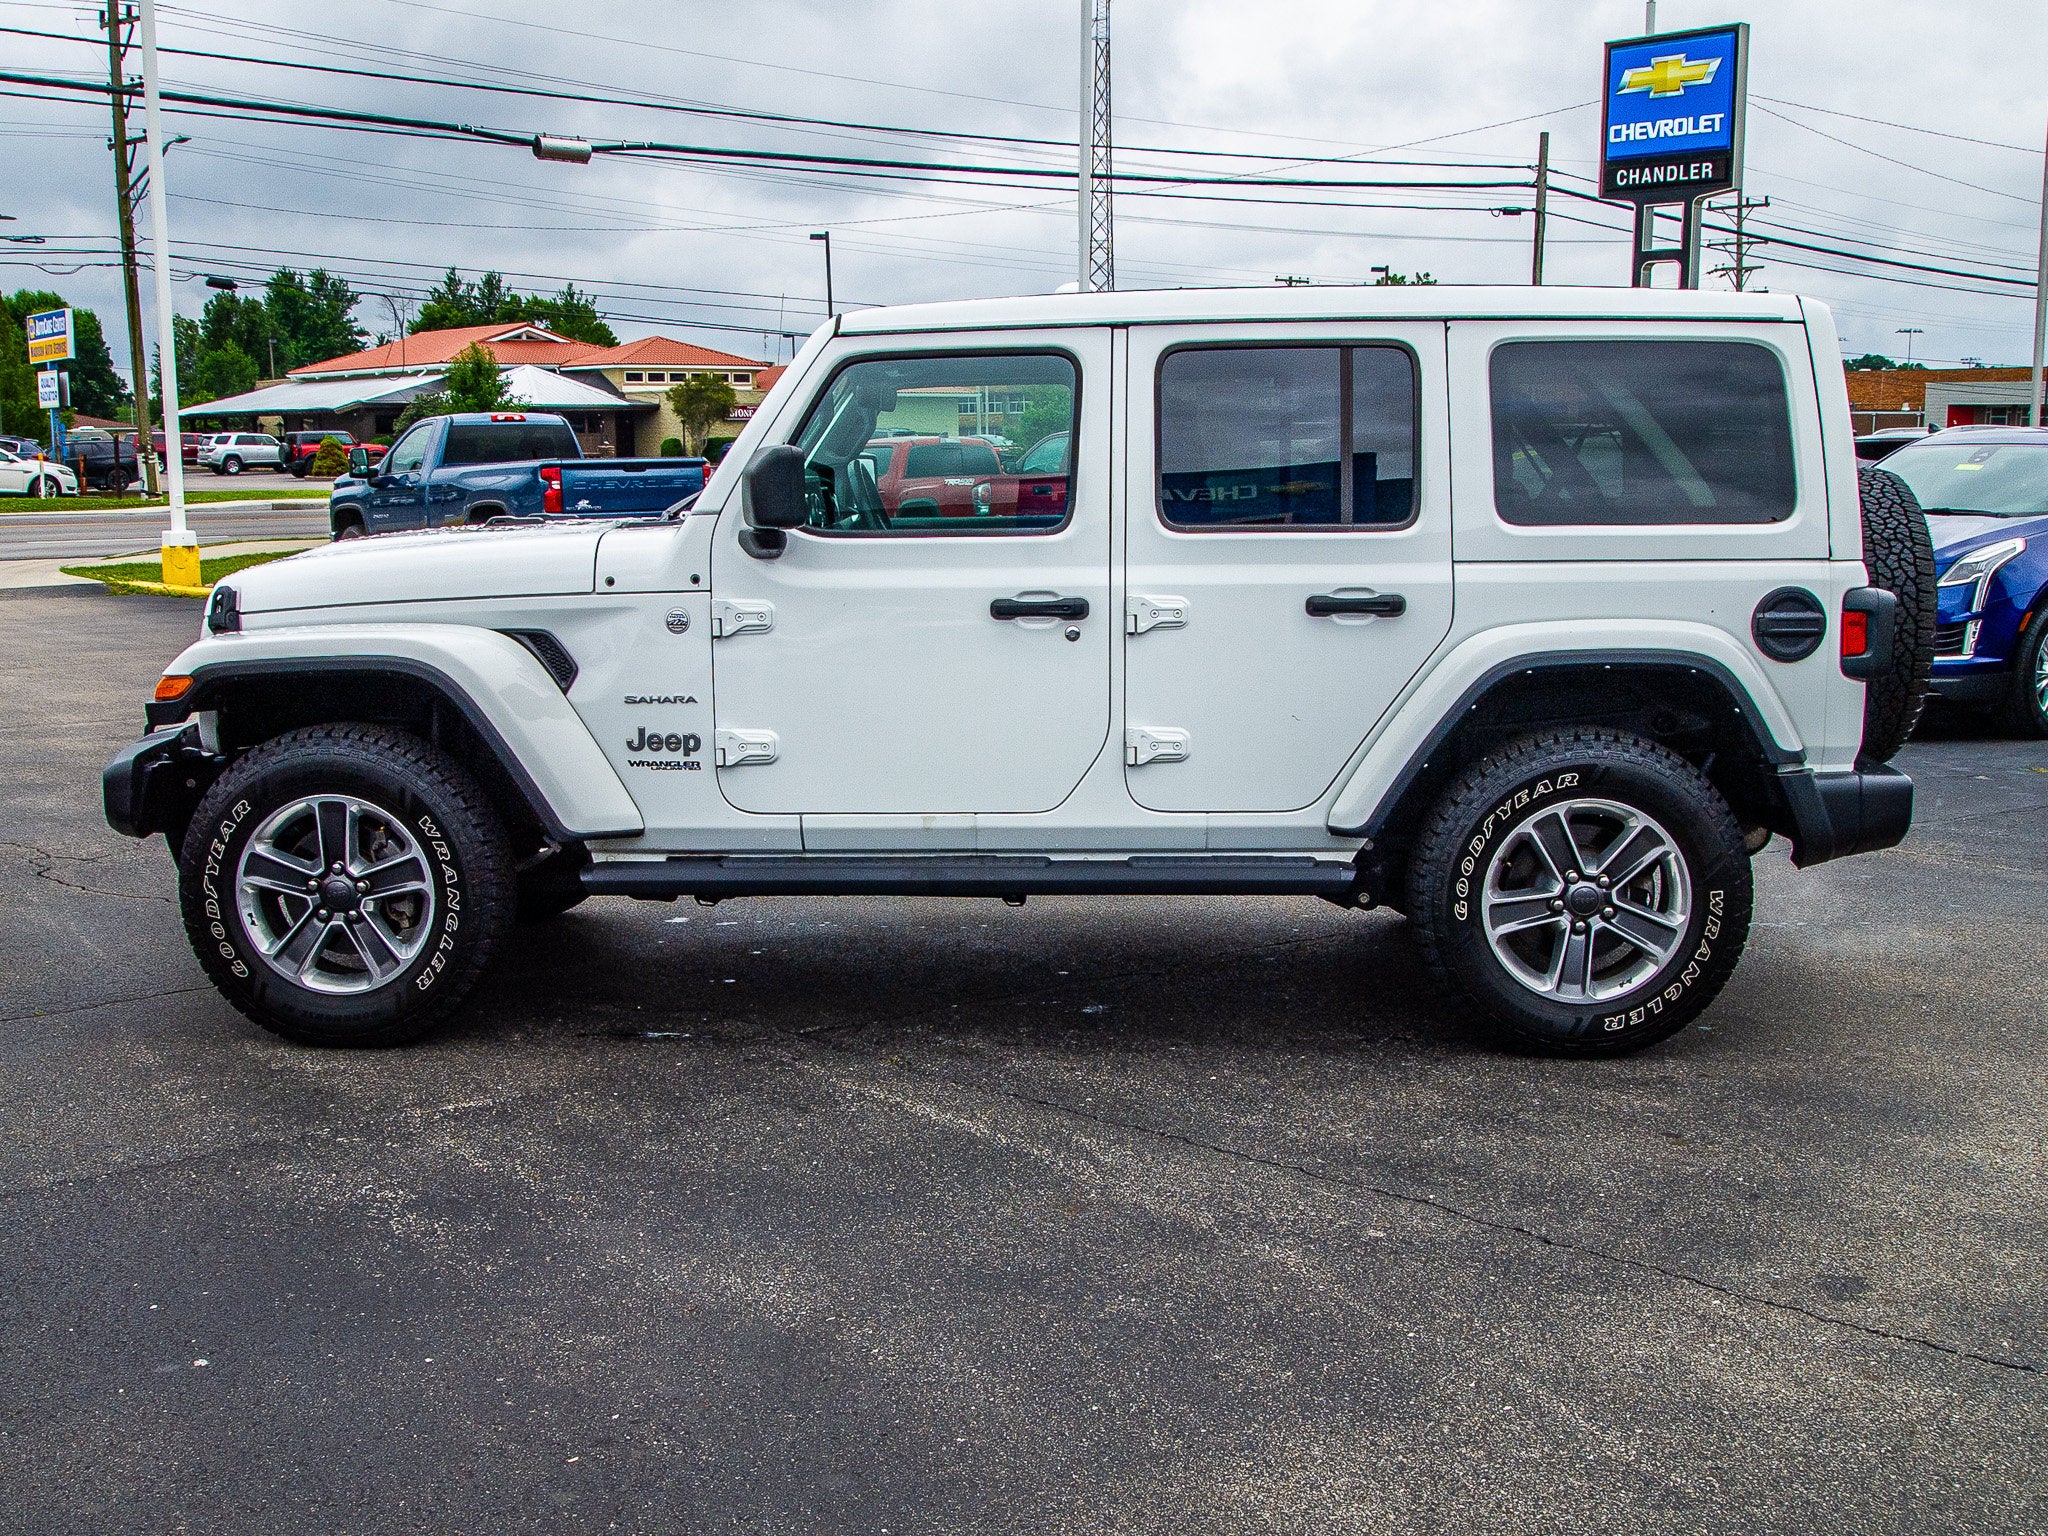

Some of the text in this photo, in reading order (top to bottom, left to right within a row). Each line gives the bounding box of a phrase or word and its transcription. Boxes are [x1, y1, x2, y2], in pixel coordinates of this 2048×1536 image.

[1609, 113, 1725, 143] CHEVROLET
[1616, 162, 1713, 186] CHANDLER
[624, 695, 698, 704] SAHARA
[626, 726, 701, 757] Jeep
[627, 759, 701, 768] WRANGLER
[1454, 773, 1579, 921] GOODYEAR
[203, 799, 251, 978] GOODYEAR
[416, 816, 460, 990] WRANGLER
[1604, 890, 1724, 1031] WRANGLER
